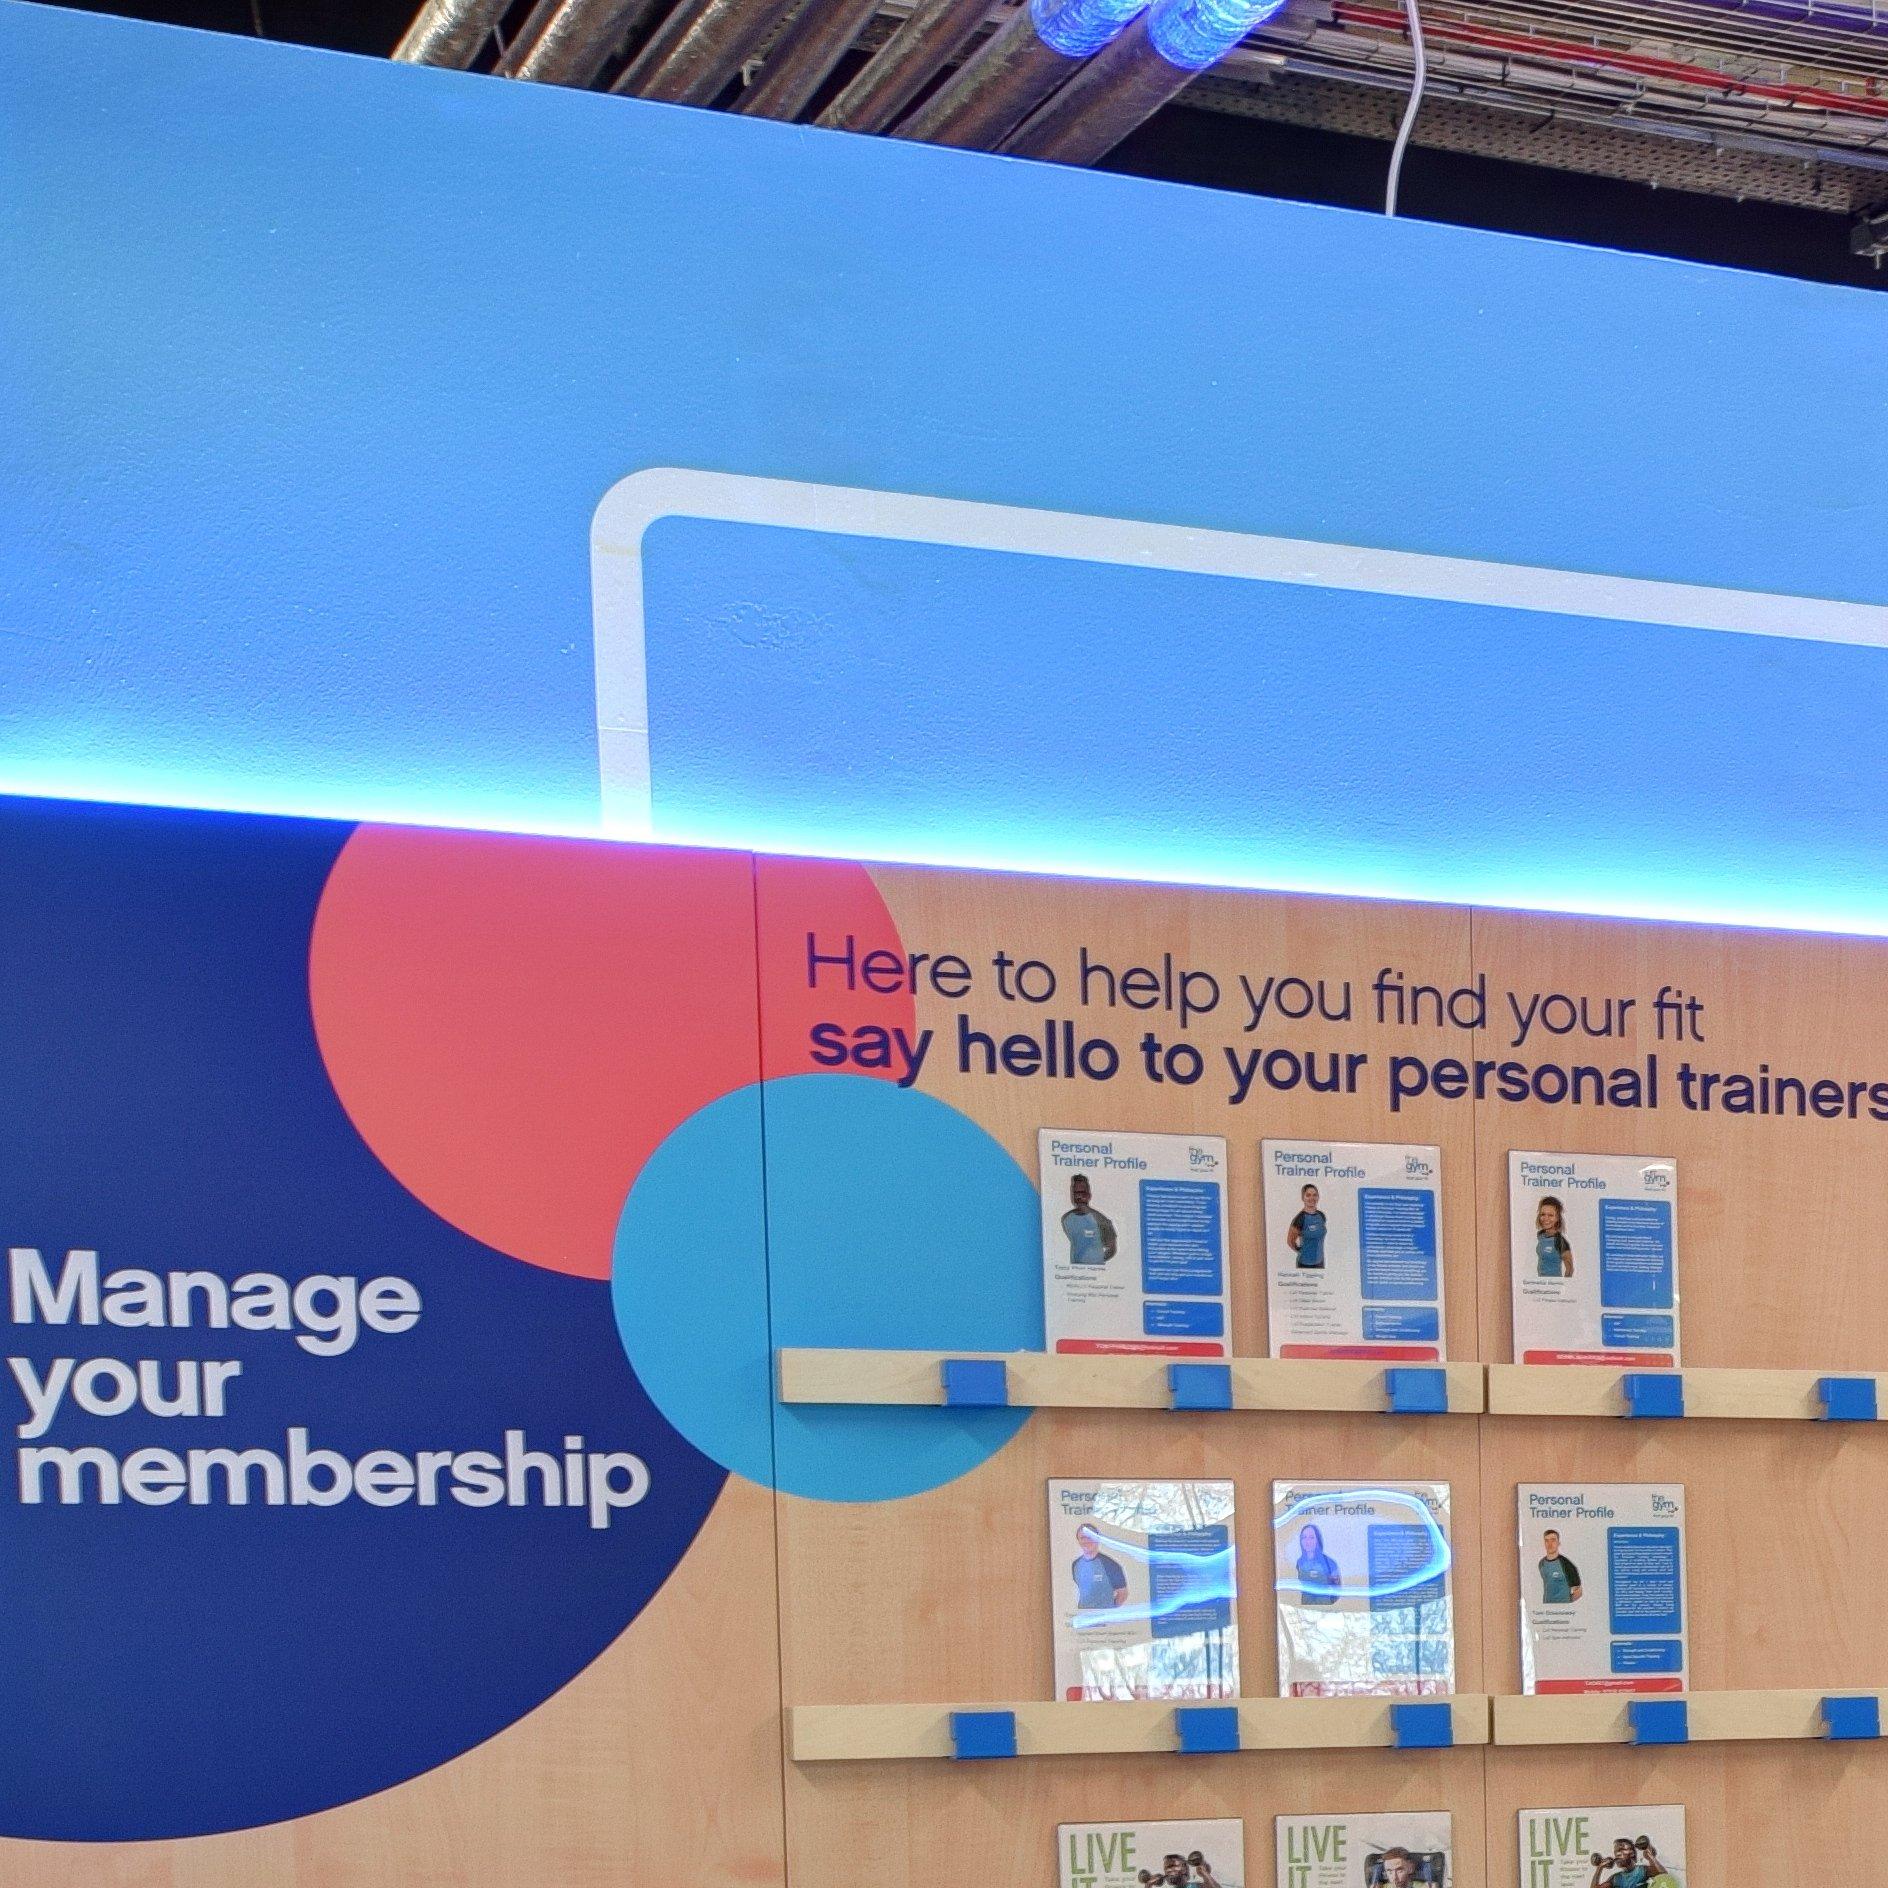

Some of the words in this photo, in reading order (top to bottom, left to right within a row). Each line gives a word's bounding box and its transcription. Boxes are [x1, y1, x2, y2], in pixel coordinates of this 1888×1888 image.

[805, 931, 973, 999] Here
[992, 949, 1057, 1003] to
[1079, 947, 1219, 1029] help
[1238, 966, 1350, 1033] you
[1372, 967, 1486, 1030] find
[1507, 985, 1635, 1049] your
[1651, 985, 1705, 1043] fit
[808, 1018, 932, 1088] say
[957, 1013, 1118, 1084] hello
[1139, 1030, 1203, 1087] to
[1224, 1042, 1362, 1105] your
[1389, 1046, 1660, 1111] personal
[1051, 1140, 1112, 1155] Personal
[1052, 1155, 1100, 1168] Trainer
[1104, 1157, 1147, 1170] Profile
[1274, 1150, 1332, 1164] Personal
[1275, 1165, 1319, 1177] Trainer
[1324, 1166, 1366, 1179] Profile
[1520, 1162, 1575, 1175] Personal
[1520, 1175, 1562, 1188] Trainer
[1567, 1177, 1607, 1190] Profile
[8, 1247, 423, 1357] Manage
[10, 1356, 243, 1438] your
[17, 1427, 651, 1529] membership
[1529, 1494, 1584, 1505] Personal
[1335, 1504, 1375, 1516] Profile
[1531, 1508, 1573, 1518] Trainer
[1576, 1508, 1614, 1518] Profile
[1287, 1825, 1347, 1864] LIVE
[1529, 1817, 1590, 1858] LIVE
[1069, 1832, 1137, 1875] LIVE
